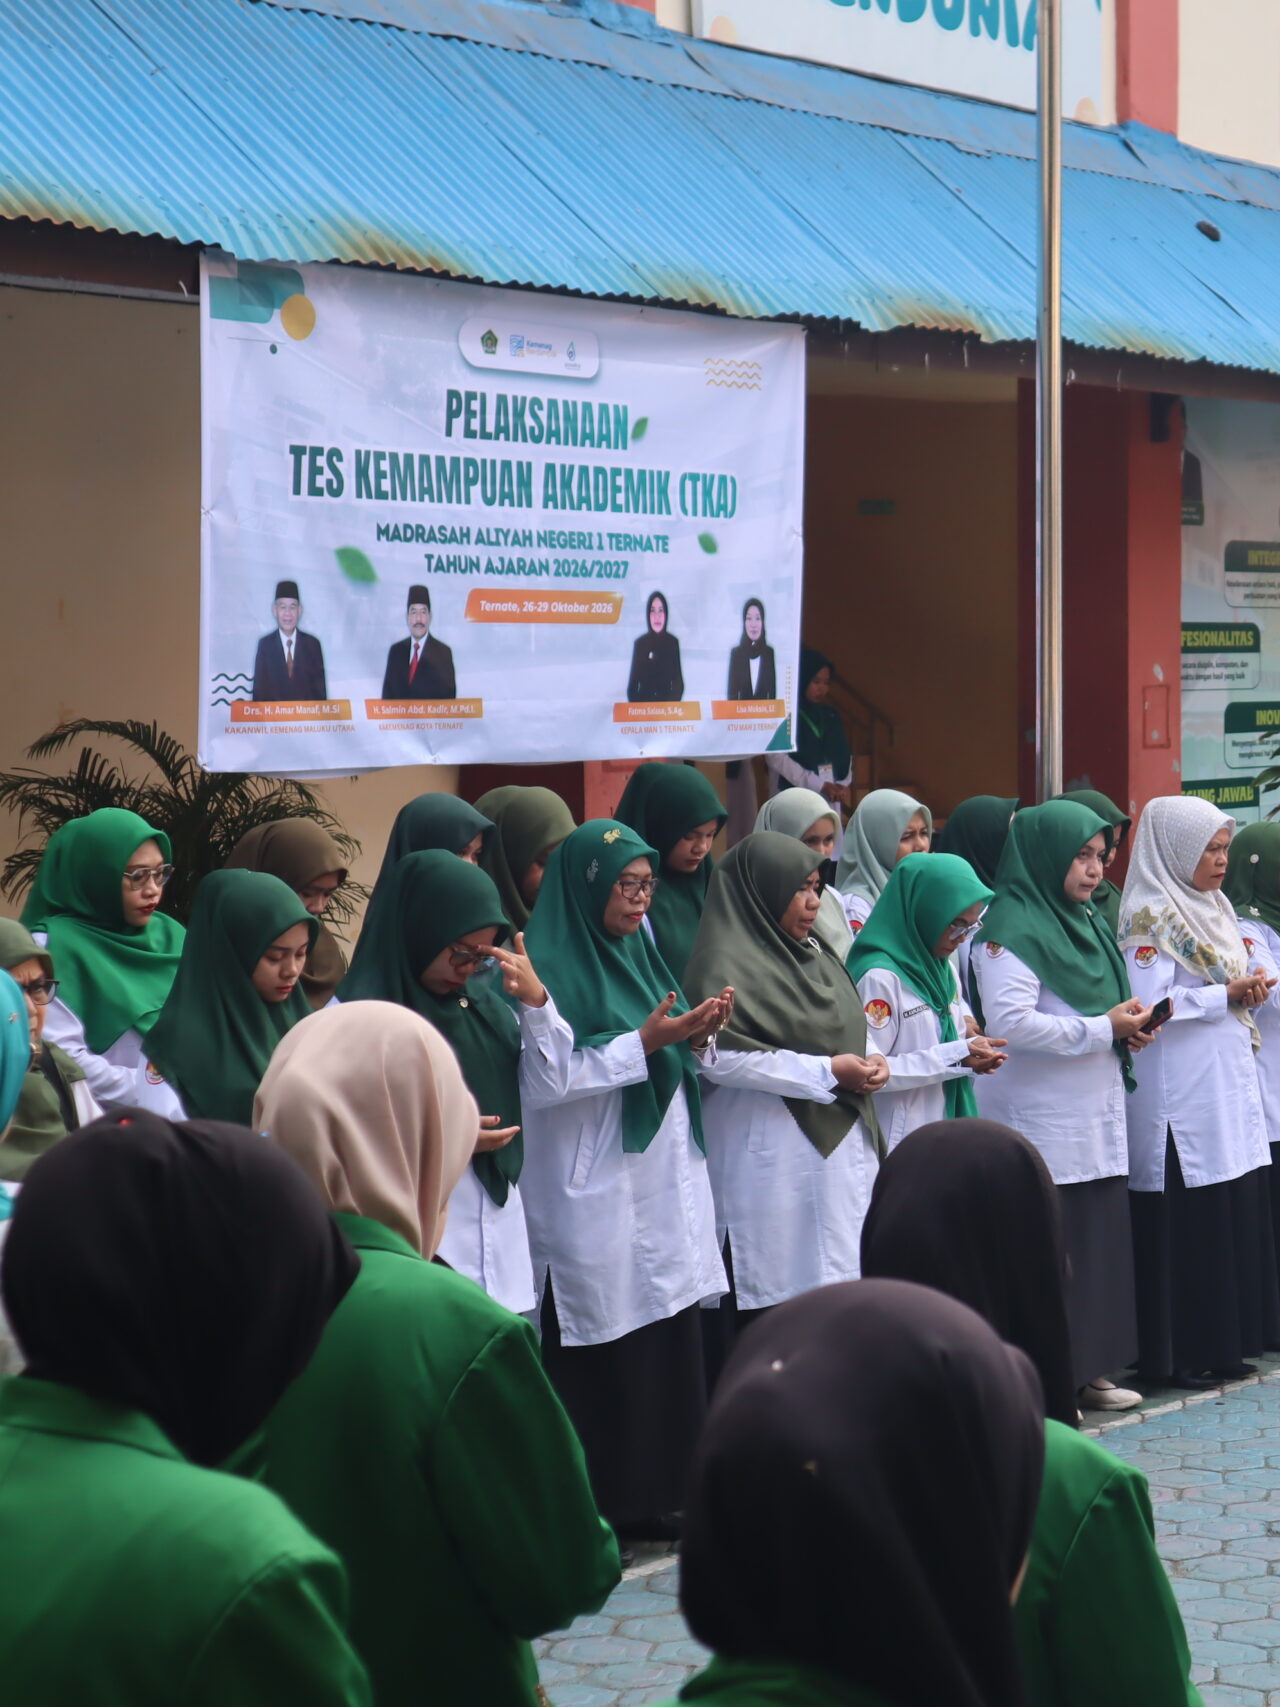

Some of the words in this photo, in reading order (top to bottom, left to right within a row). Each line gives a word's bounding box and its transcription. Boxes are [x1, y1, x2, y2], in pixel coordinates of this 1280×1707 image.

[445, 388, 629, 450] PELAKSANAAN
[289, 444, 344, 498] TES
[355, 449, 533, 508] KEMAMPUAN
[542, 462, 671, 516] AKADEMIK
[679, 472, 737, 519] (TKA)
[376, 522, 471, 545] MADRASAH
[474, 527, 533, 547] ALIYAH
[537, 529, 593, 550] NEGERI
[596, 532, 604, 551] 1
[606, 532, 670, 553] TERNATE
[424, 553, 480, 574] TAHUN
[484, 555, 550, 576] AJARAN
[553, 558, 629, 579] 2026/2027
[479, 600, 520, 613] Ternate,
[522, 601, 549, 612] 26-29
[551, 602, 589, 613] Oktober
[591, 603, 613, 613] 2026
[243, 705, 262, 715] Drs.
[264, 705, 273, 715] H.
[381, 704, 406, 714] Salmin
[408, 704, 425, 714] Abd.
[224, 725, 269, 735] KAKANWIL
